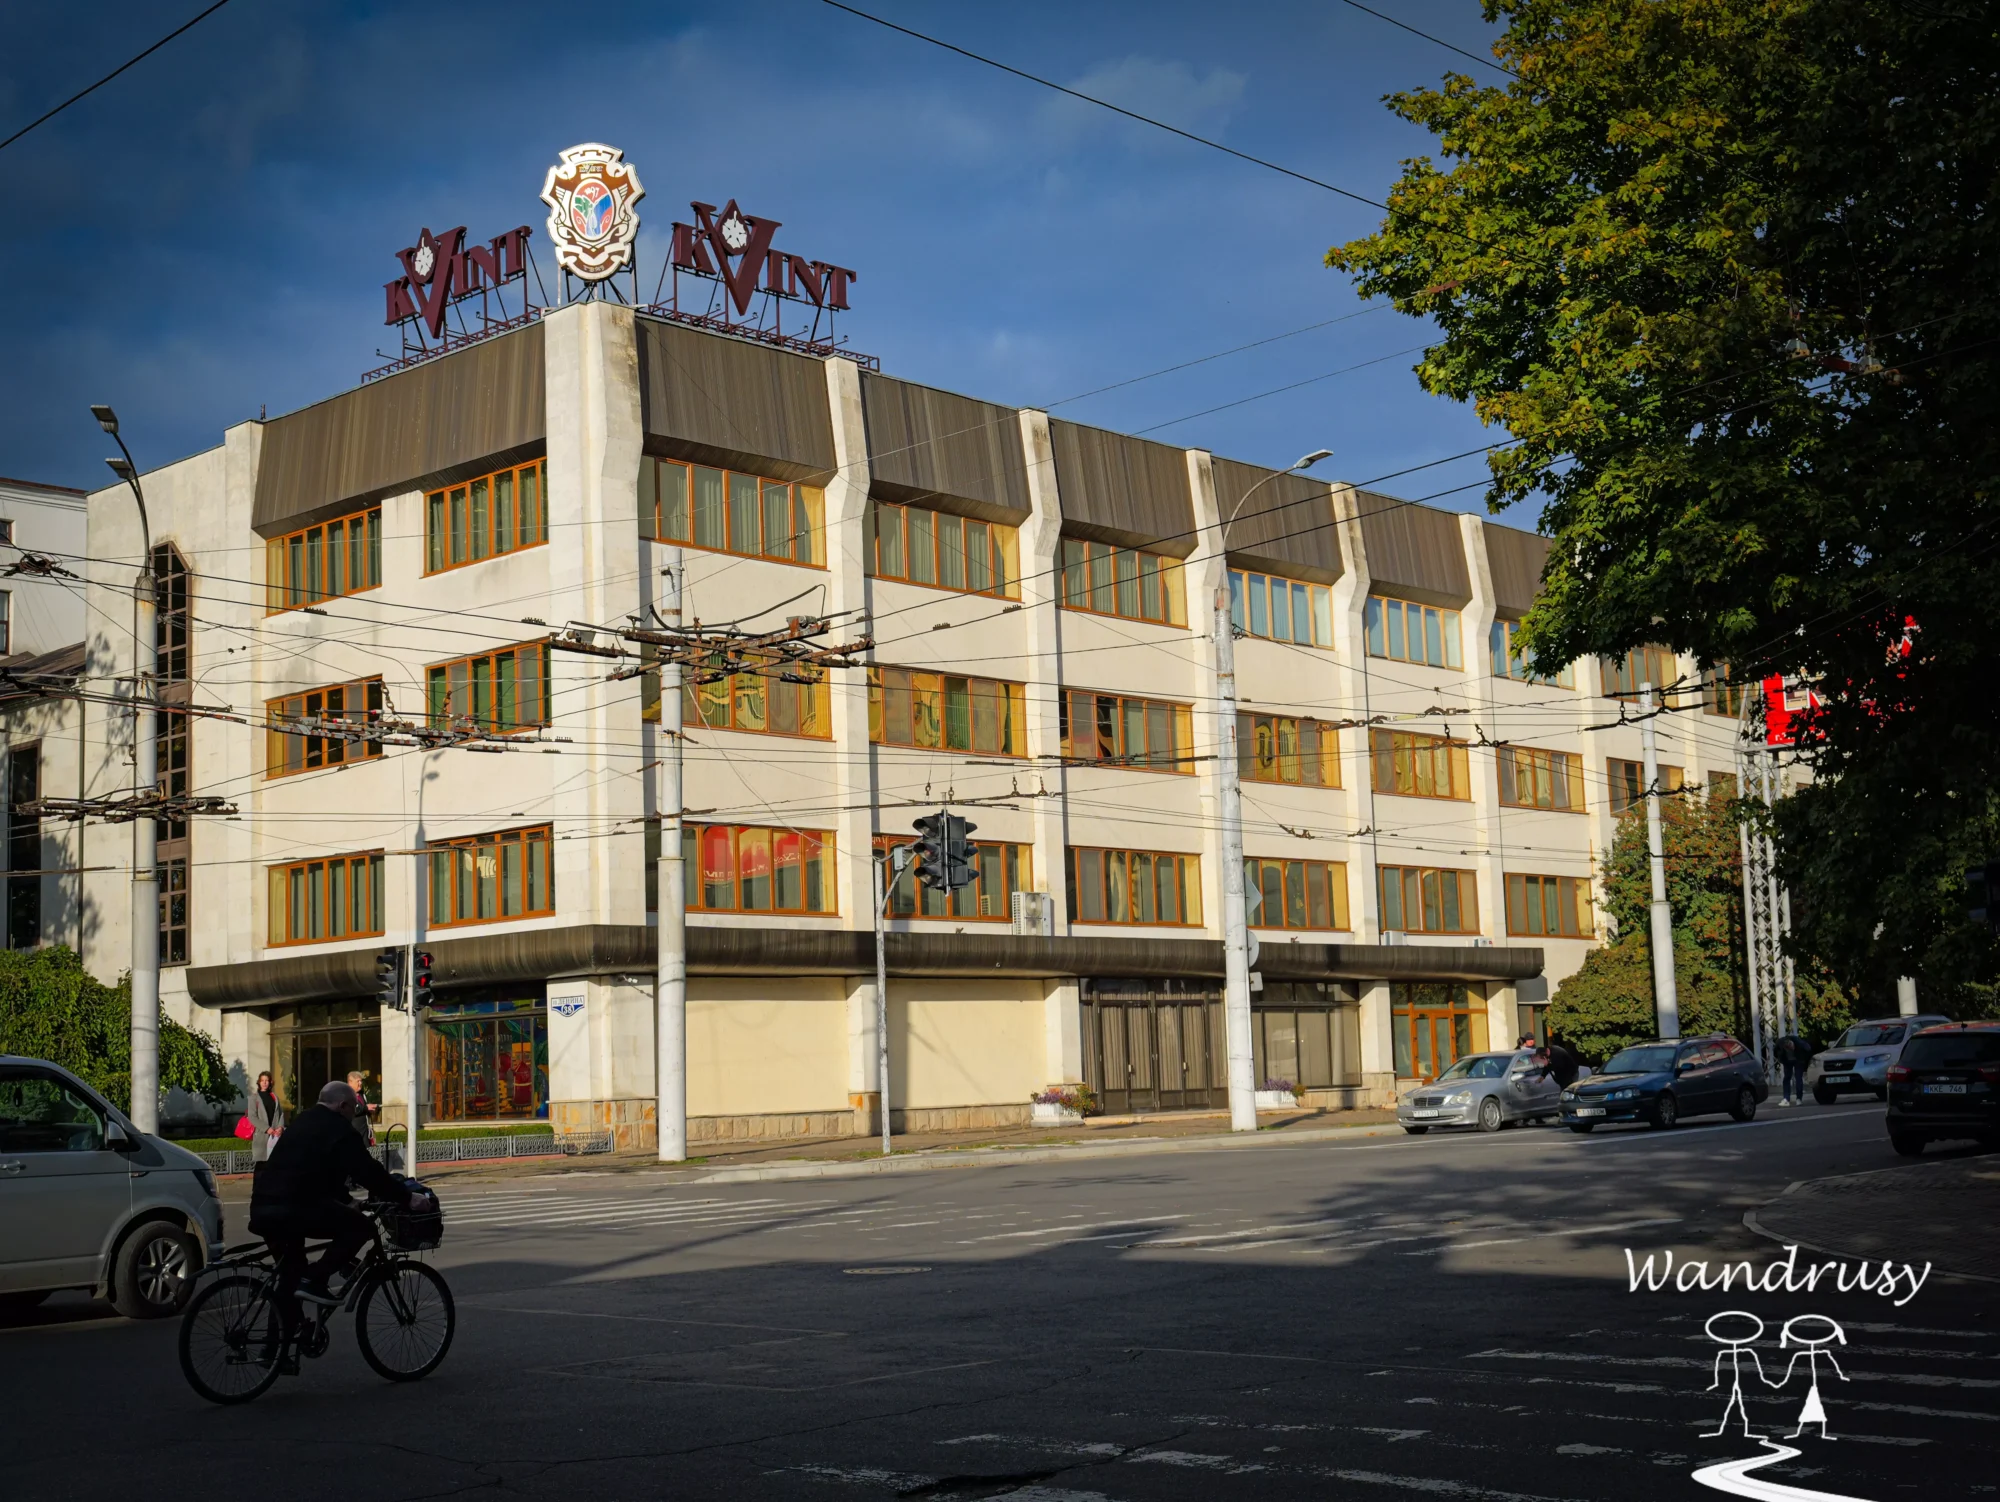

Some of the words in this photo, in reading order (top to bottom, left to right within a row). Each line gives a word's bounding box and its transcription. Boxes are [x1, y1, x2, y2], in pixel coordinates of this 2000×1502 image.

[382, 226, 533, 339] KVINT
[671, 200, 857, 317] KVINT
[563, 1005, 572, 1014] 38
[1929, 1085, 1943, 1093] KKE
